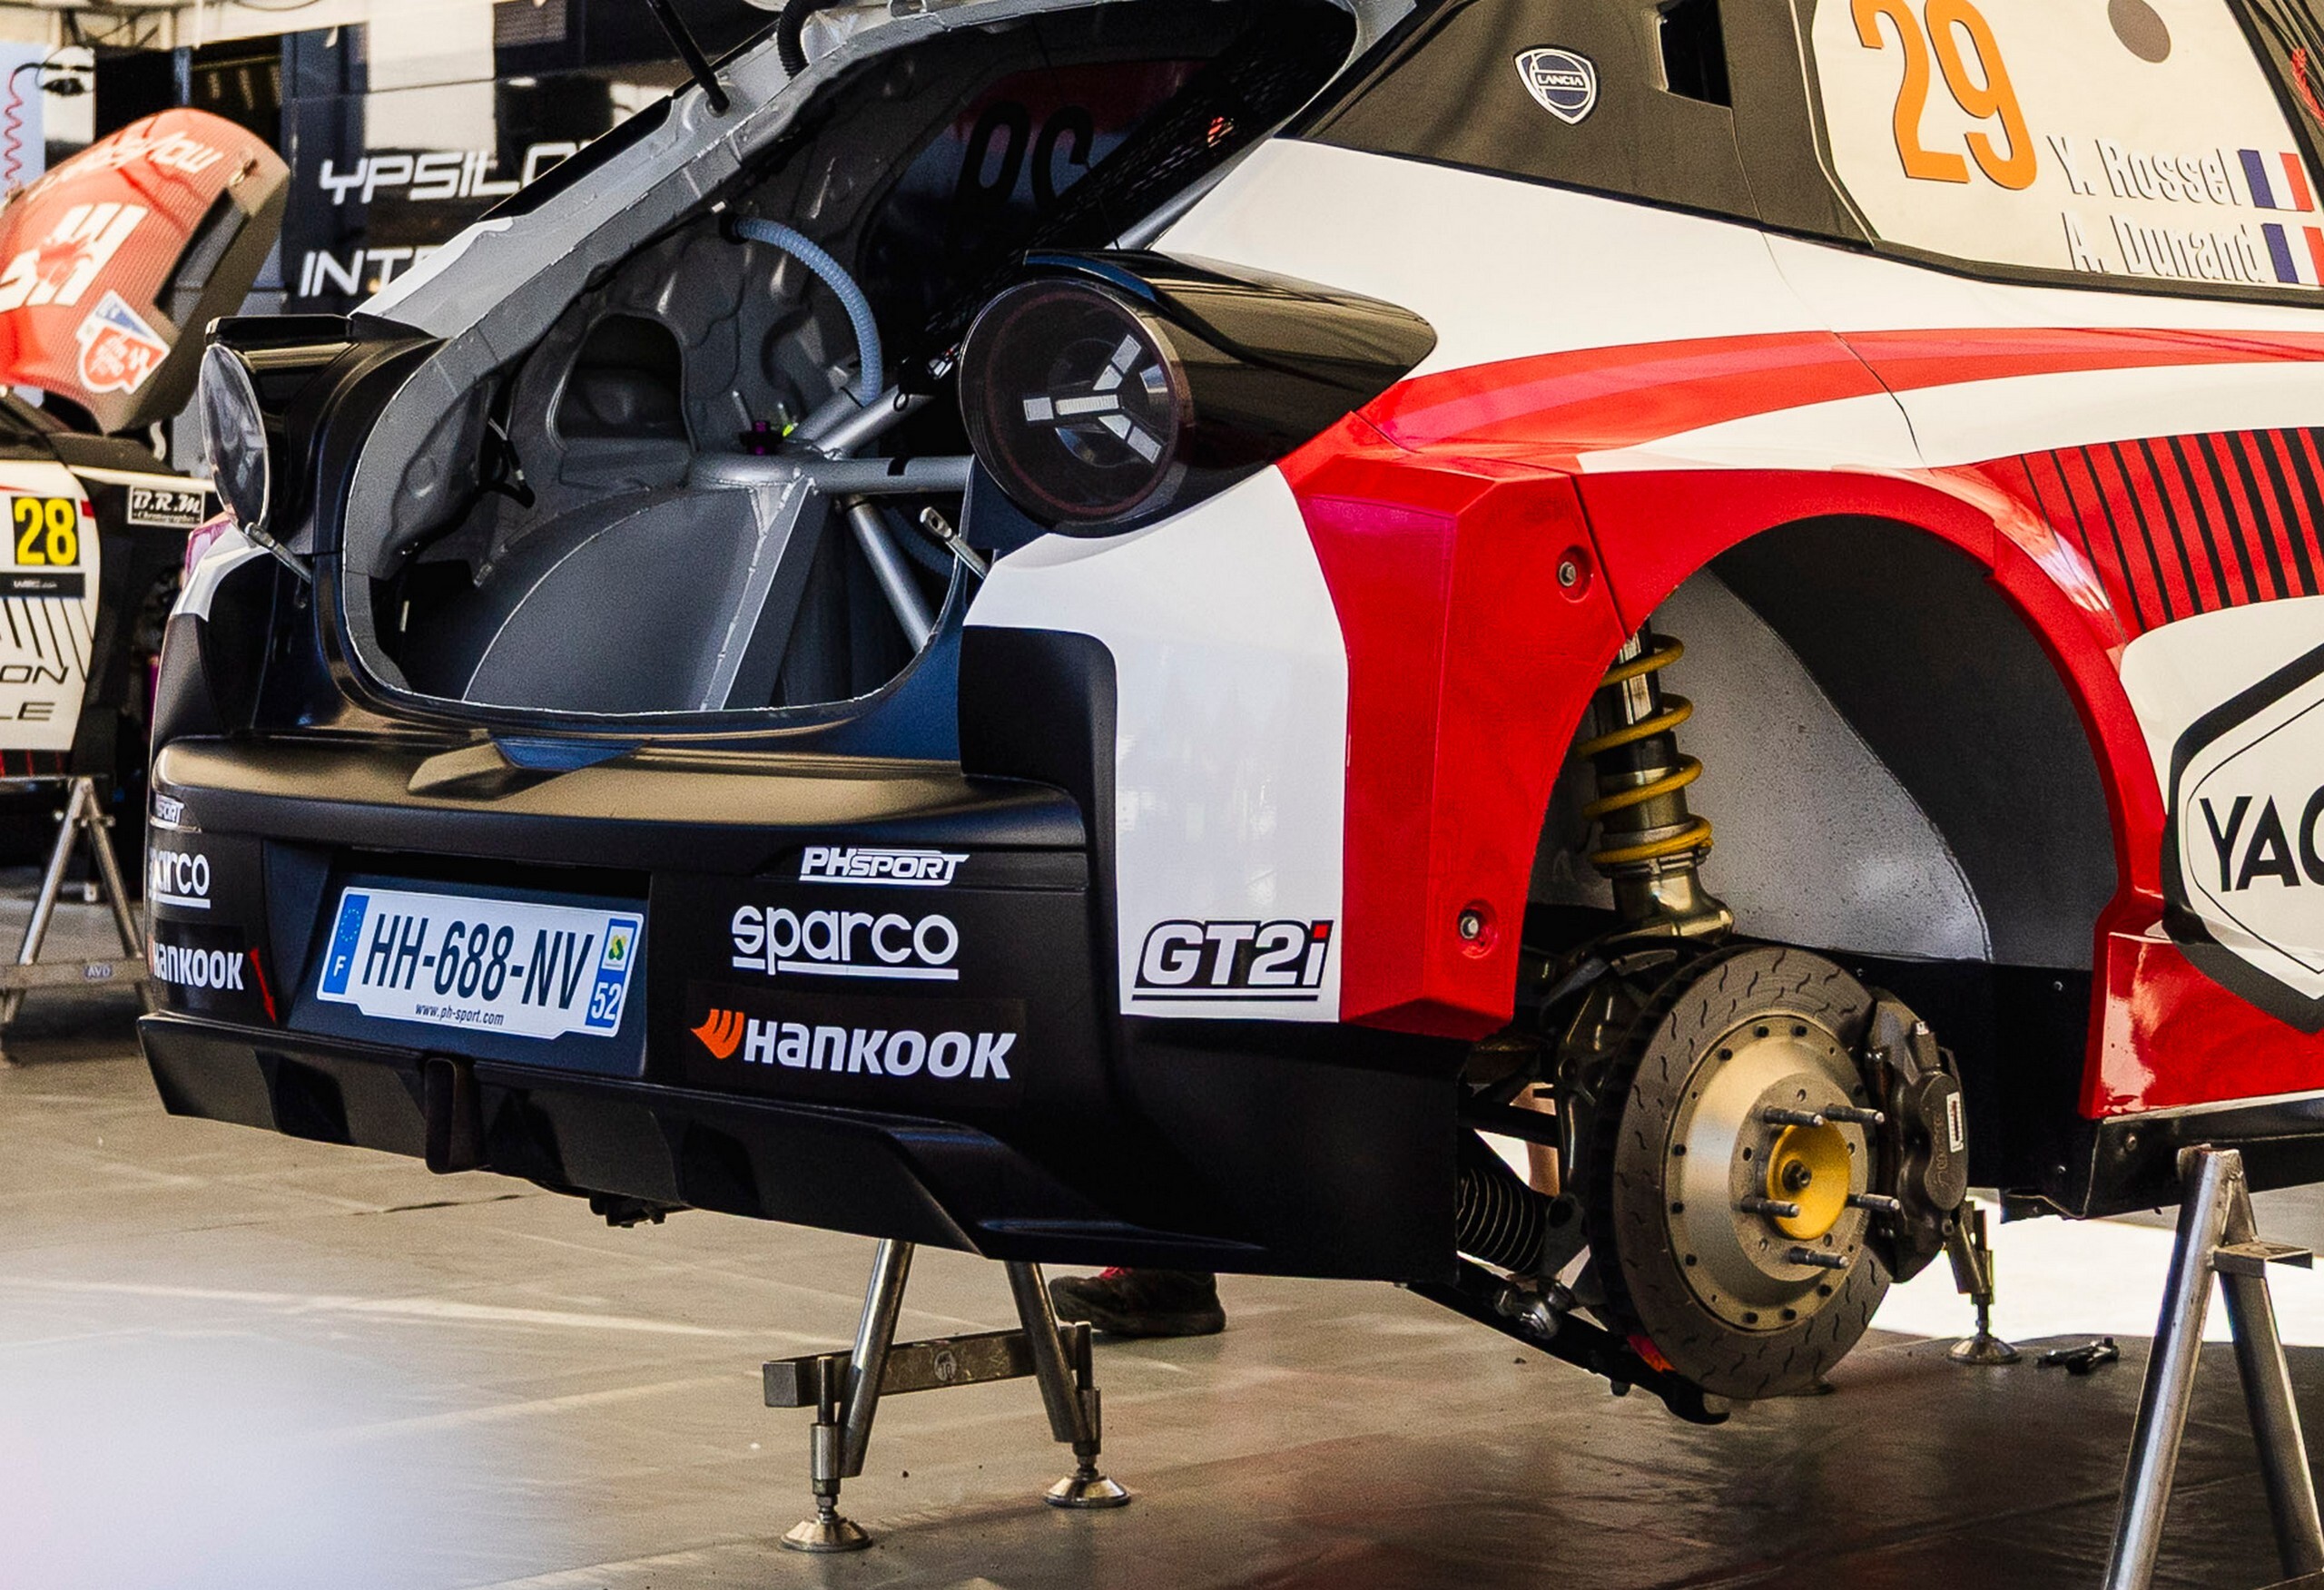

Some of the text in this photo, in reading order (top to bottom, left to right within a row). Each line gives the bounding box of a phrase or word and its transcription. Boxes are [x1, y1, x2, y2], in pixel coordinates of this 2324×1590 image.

[1537, 74, 1584, 87] LANCIA
[1850, 0, 2037, 191] 29
[320, 140, 595, 205] YPSILO
[2045, 134, 2242, 206] Y. Rossel
[2061, 211, 2110, 273] A.
[14, 497, 77, 566] 28
[333, 956, 347, 977] F
[361, 913, 595, 1010] HH-688-NV
[732, 905, 959, 978] sparco
[1138, 919, 1334, 989] GT2i
[414, 1002, 505, 1026] www.ph-sport.com
[590, 981, 623, 1021] 52
